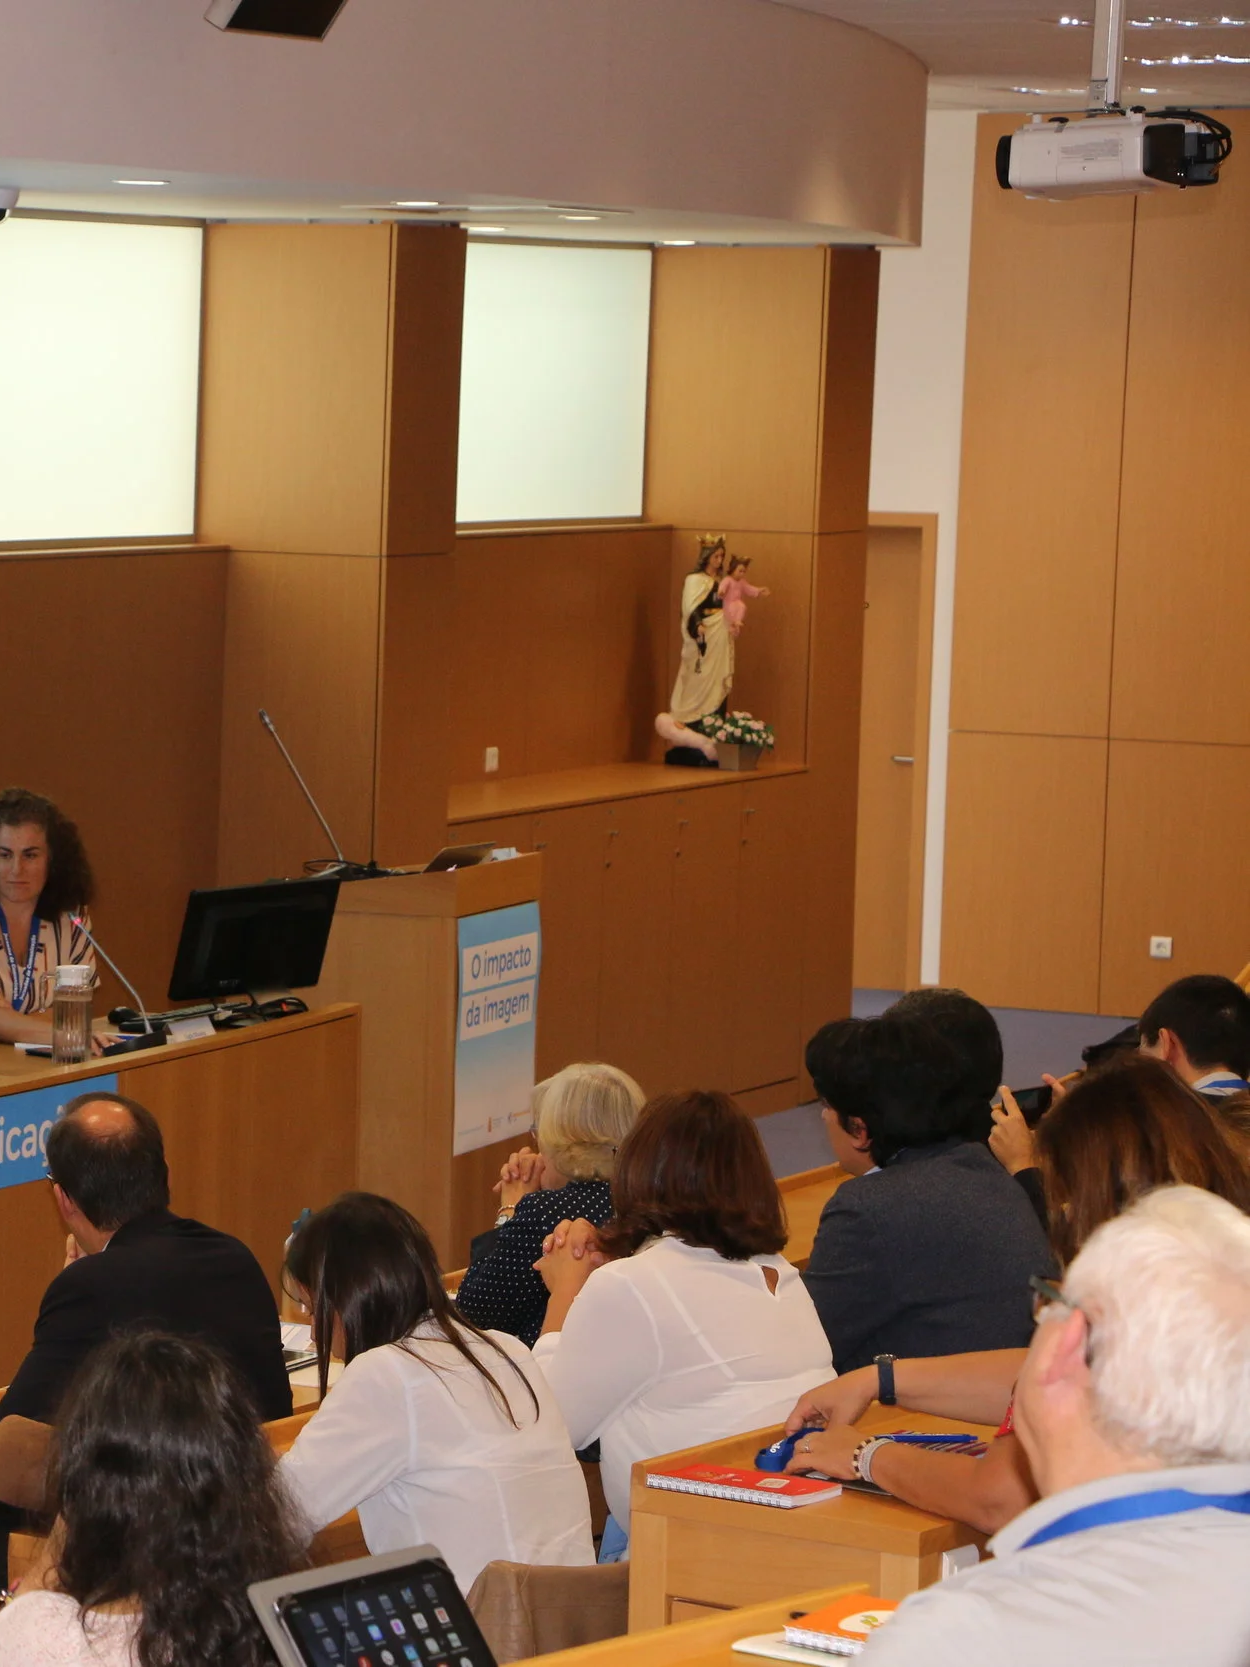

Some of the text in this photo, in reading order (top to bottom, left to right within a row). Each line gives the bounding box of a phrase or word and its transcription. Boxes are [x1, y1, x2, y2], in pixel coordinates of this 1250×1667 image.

[471, 945, 532, 980] O impacto
[465, 992, 530, 1028] da imagem
